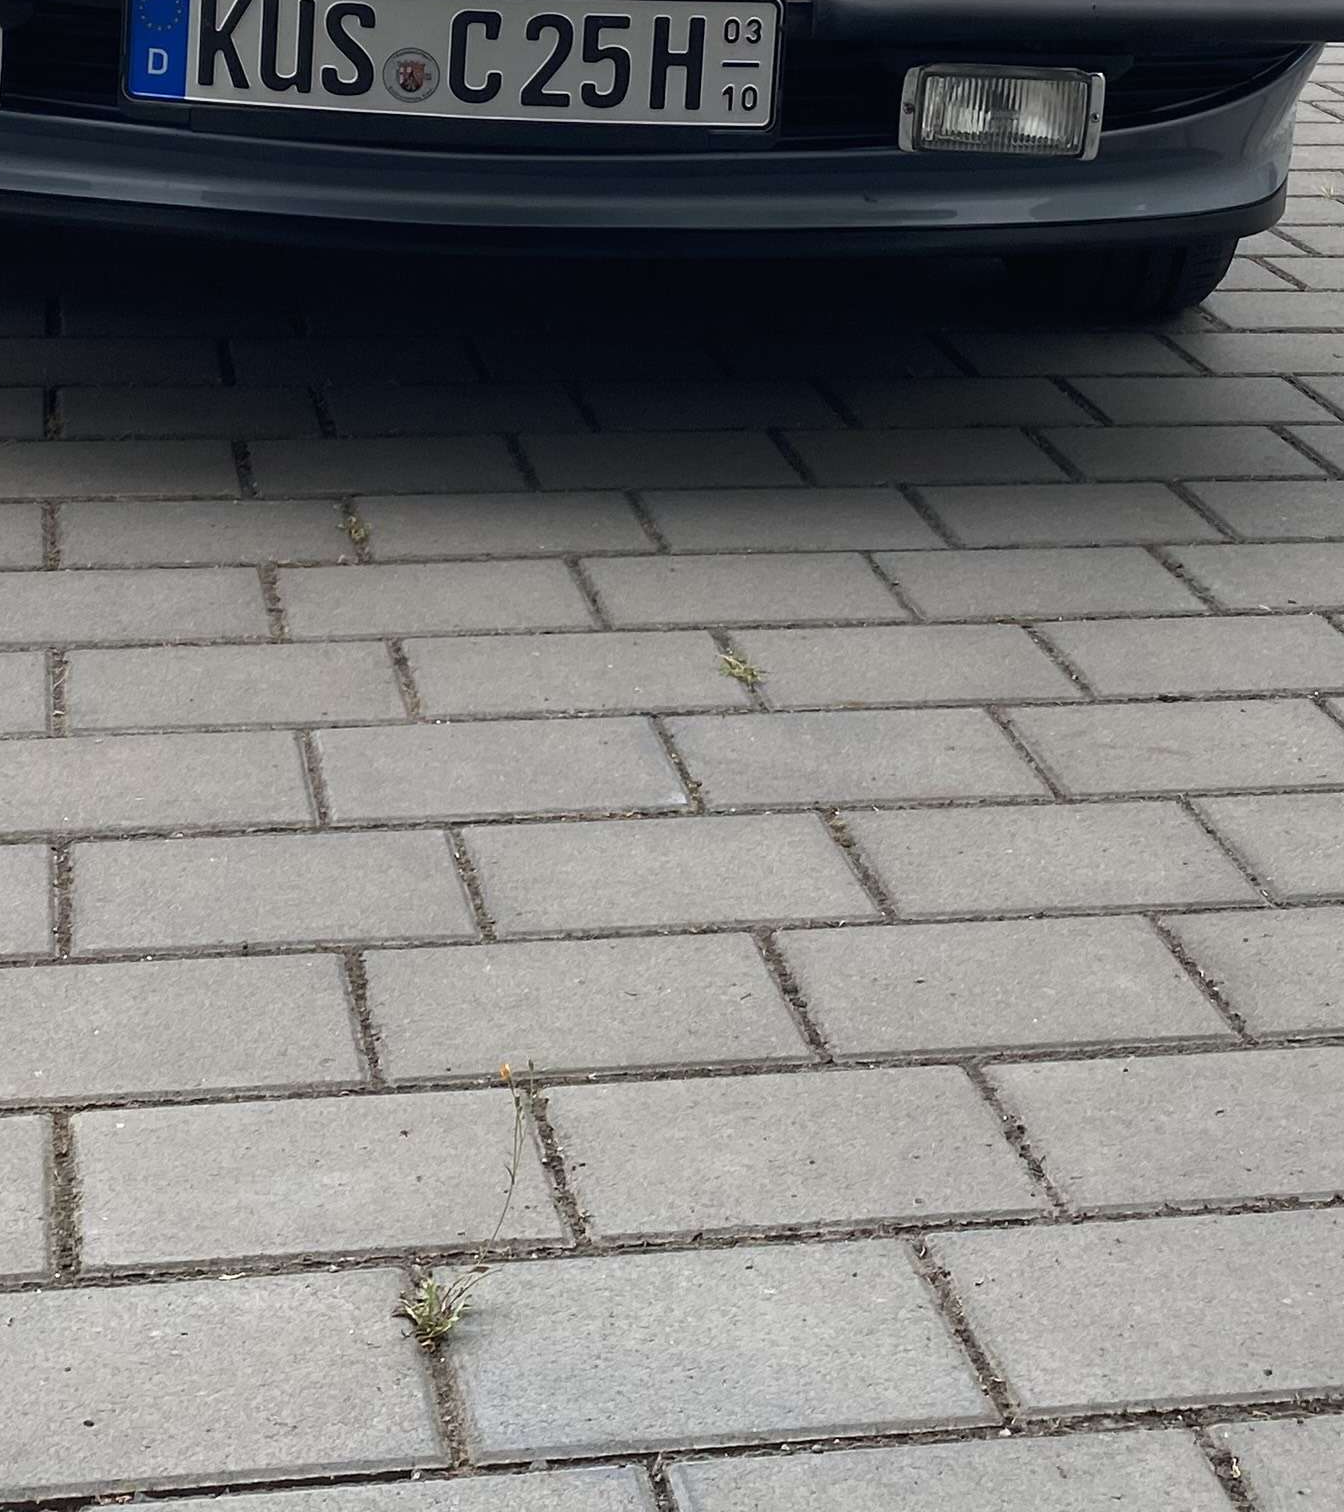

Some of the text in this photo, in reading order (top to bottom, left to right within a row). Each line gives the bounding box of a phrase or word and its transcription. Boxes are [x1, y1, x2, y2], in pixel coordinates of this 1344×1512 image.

[722, 16, 763, 44] 03
[146, 48, 168, 75] D
[721, 84, 759, 113] 10
